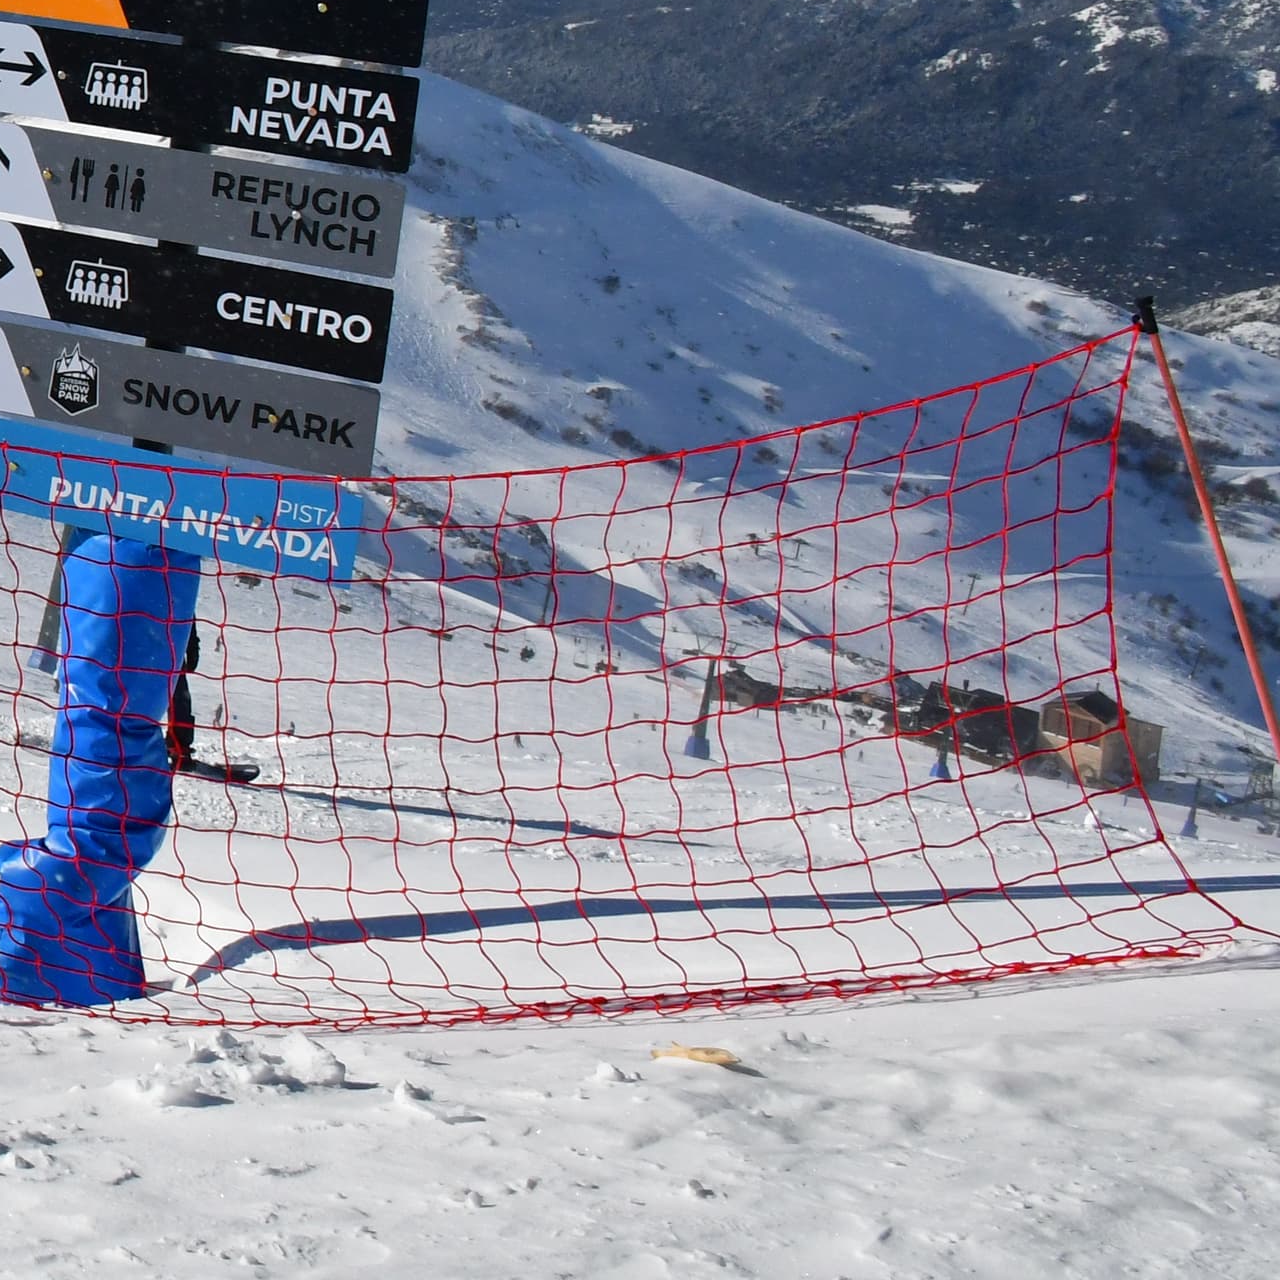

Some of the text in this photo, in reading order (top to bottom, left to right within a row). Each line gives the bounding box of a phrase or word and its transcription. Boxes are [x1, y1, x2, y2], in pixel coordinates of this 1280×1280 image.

[265, 76, 395, 122] PUNTA
[230, 105, 392, 156] NEVADA
[211, 171, 380, 222] REFUGIO
[251, 210, 376, 256] LYNCH
[216, 292, 372, 344] CENTRO
[58, 390, 88, 403] PARK
[59, 383, 89, 393] SNOW
[123, 379, 356, 449] SNOW PARK
[48, 476, 339, 567] PUNTA NEVADA
[277, 500, 340, 529] PISTA
